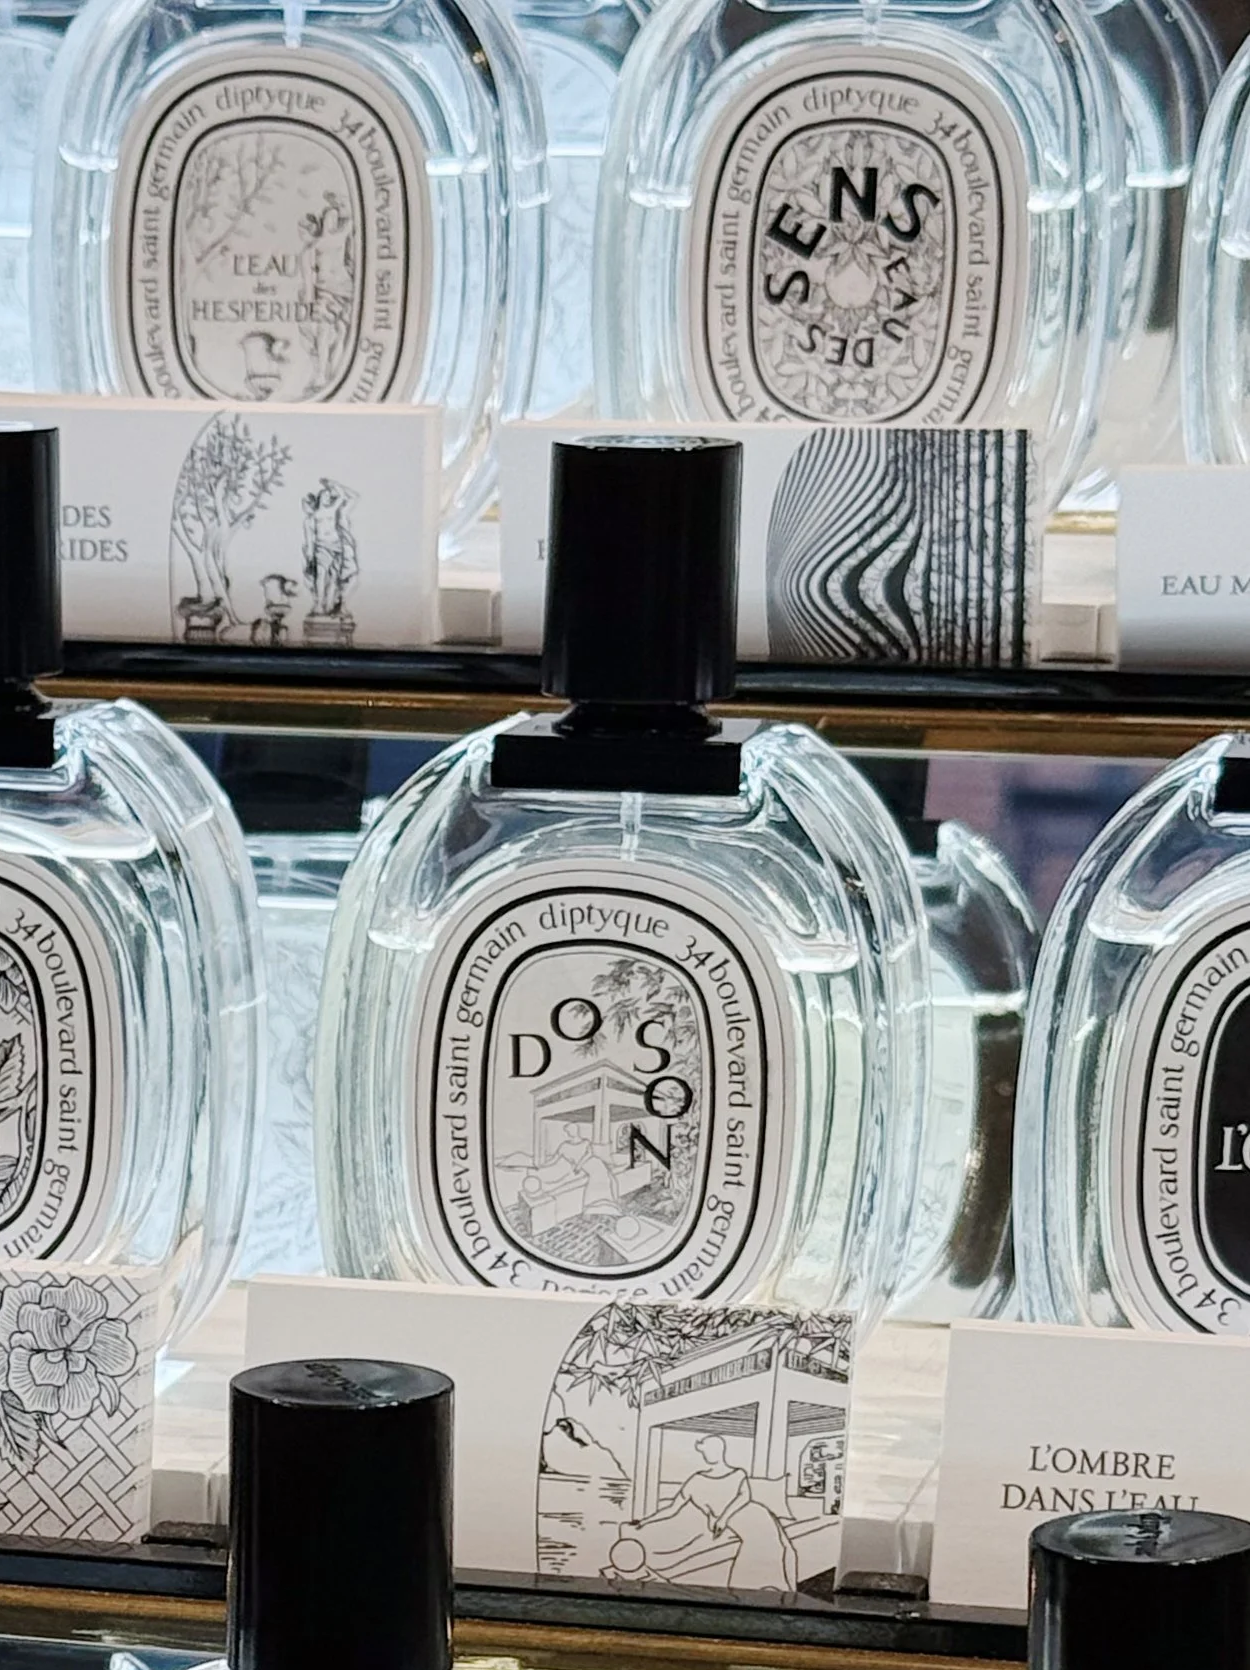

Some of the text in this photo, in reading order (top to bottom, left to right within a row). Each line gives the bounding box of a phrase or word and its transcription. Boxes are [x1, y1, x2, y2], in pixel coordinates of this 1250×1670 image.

[214, 84, 328, 116] diptyque
[802, 85, 924, 116] diptyque
[923, 109, 960, 141] 34
[148, 102, 208, 202] germain
[726, 104, 792, 206] germain
[356, 125, 400, 265] boulevard
[951, 127, 992, 268] boulevard
[141, 204, 163, 271] saint
[718, 209, 742, 279] saint
[763, 166, 941, 306] SENS
[372, 267, 398, 333] saint
[961, 270, 990, 339] saint
[137, 277, 181, 399] oulevard
[713, 283, 758, 418] boulevard
[1160, 573, 1221, 597] EAU
[4, 907, 41, 945] 34
[538, 902, 671, 941] diptyque
[674, 934, 715, 971] 34
[36, 929, 84, 1076] boulevard
[457, 919, 528, 1031] germain
[447, 1034, 472, 1104] saint
[707, 961, 754, 1109] boulevard
[59, 1079, 81, 1155] saint
[724, 1117, 753, 1191] saint
[1151, 947, 1250, 1328] 34 boulevard saint germain
[3, 1156, 73, 1258] germain
[442, 1112, 492, 1261] boulevard
[658, 1194, 736, 1296] germain
[1000, 1483, 1096, 1513] DANS
[1028, 1443, 1177, 1481] L'OMBRE
